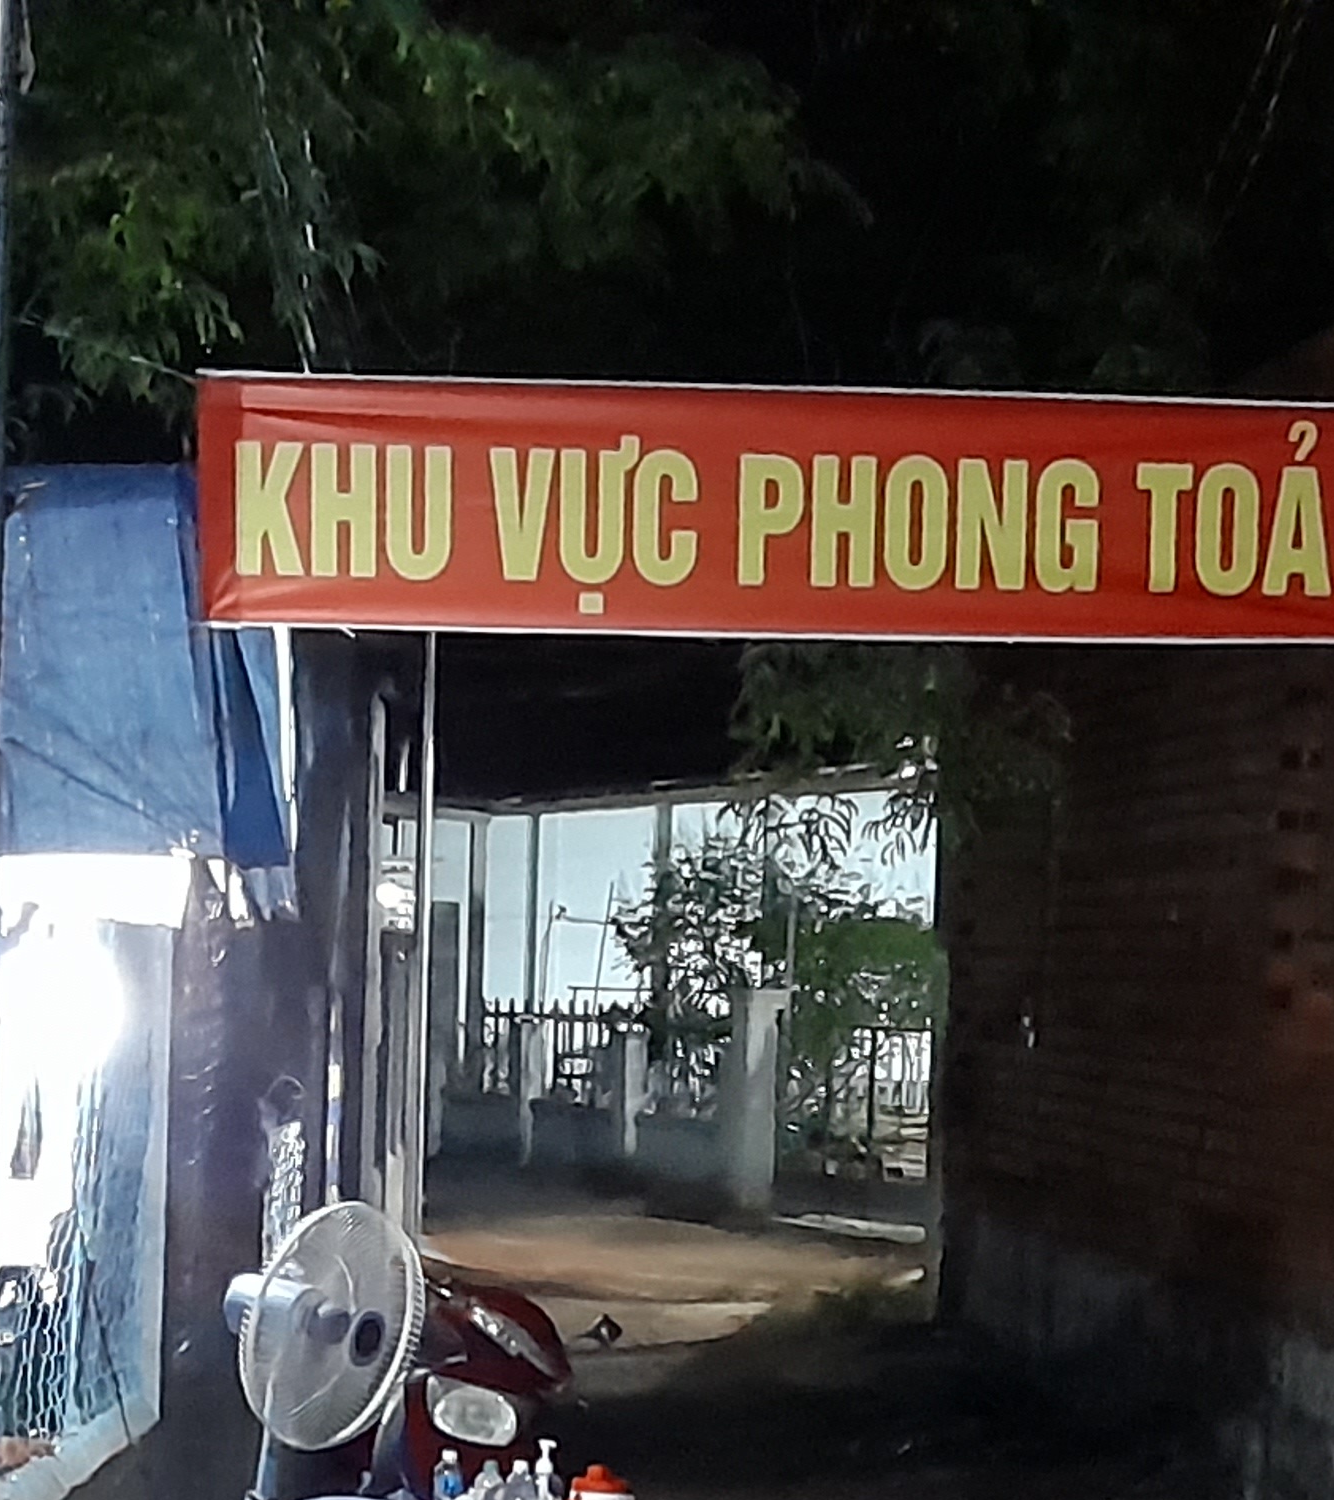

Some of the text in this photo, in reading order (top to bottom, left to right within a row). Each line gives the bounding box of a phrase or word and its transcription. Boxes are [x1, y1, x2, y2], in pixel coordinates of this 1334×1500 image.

[235, 421, 1332, 615] KHU VỰC PHONG TOẢ
